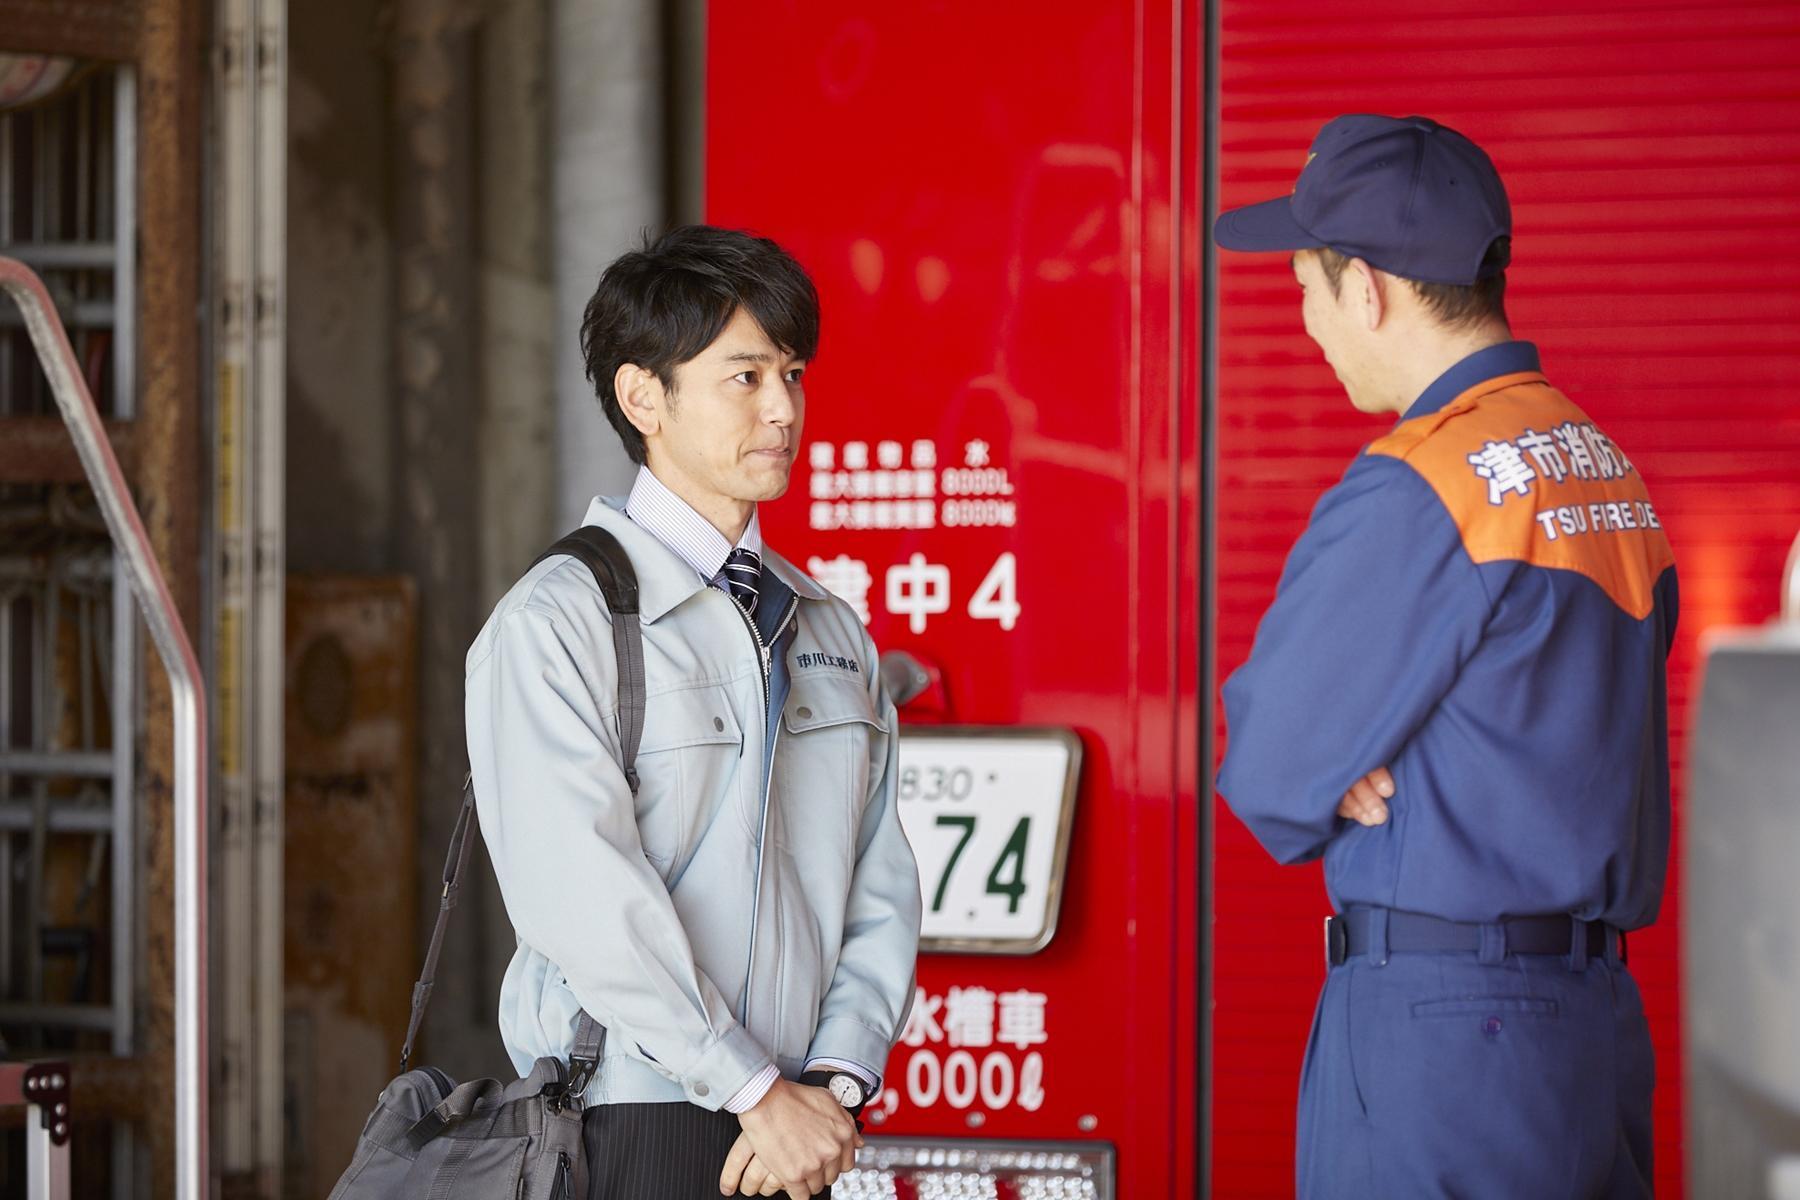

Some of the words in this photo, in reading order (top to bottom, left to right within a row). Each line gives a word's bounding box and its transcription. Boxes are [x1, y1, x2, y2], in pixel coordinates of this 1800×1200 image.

[1467, 423, 1632, 504] 津市消防
[1536, 504, 1588, 541] TSU
[1588, 502, 1638, 532] FIRE
[932, 815, 1031, 913] 74
[865, 1049, 1045, 1115] ,000ℓ
